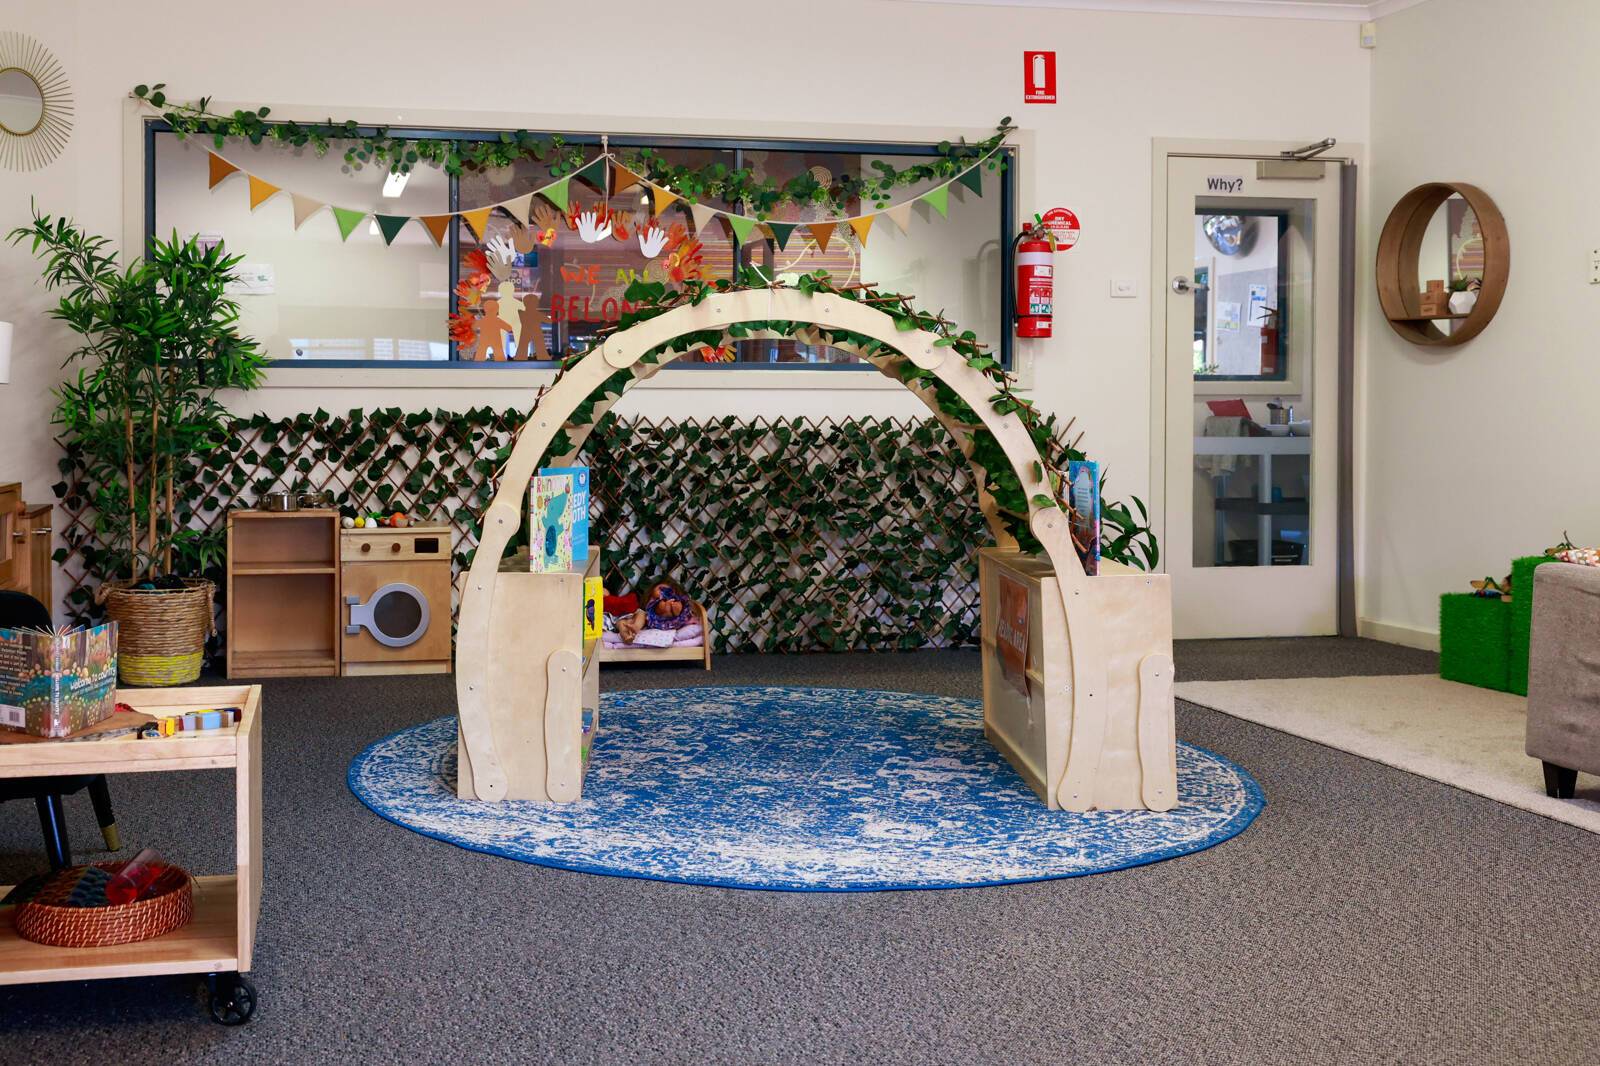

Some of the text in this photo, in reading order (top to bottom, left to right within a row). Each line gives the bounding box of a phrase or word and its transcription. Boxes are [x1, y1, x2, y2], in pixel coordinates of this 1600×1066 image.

[1207, 178, 1243, 193] Why?
[560, 265, 600, 284] WE
[551, 293, 641, 323] BELON
[573, 491, 587, 508] EDY
